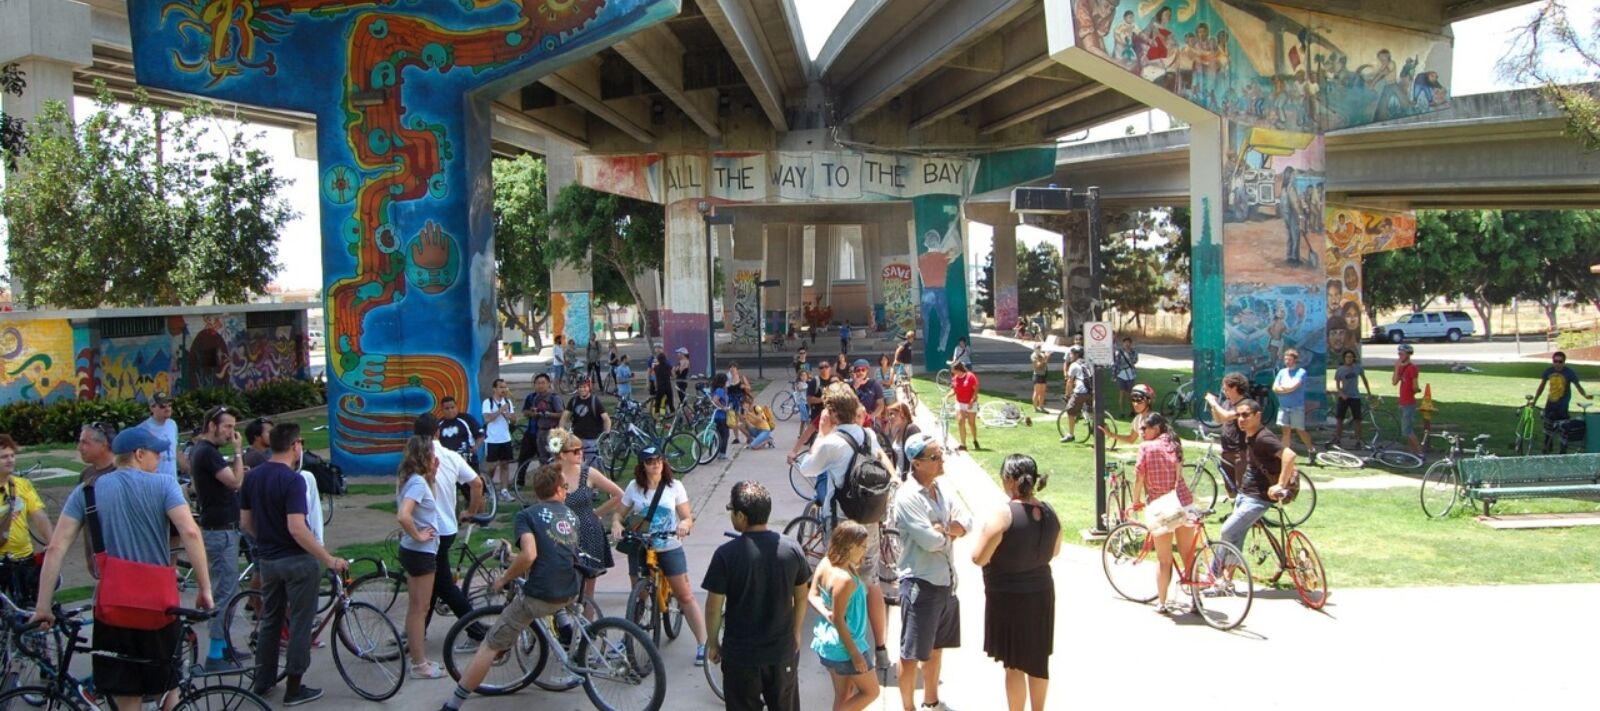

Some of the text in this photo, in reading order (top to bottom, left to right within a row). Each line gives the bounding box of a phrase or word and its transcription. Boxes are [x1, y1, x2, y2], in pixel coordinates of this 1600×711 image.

[668, 160, 964, 191] ALL THE WAY TO THE BAY
[882, 265, 912, 279] SAVE
